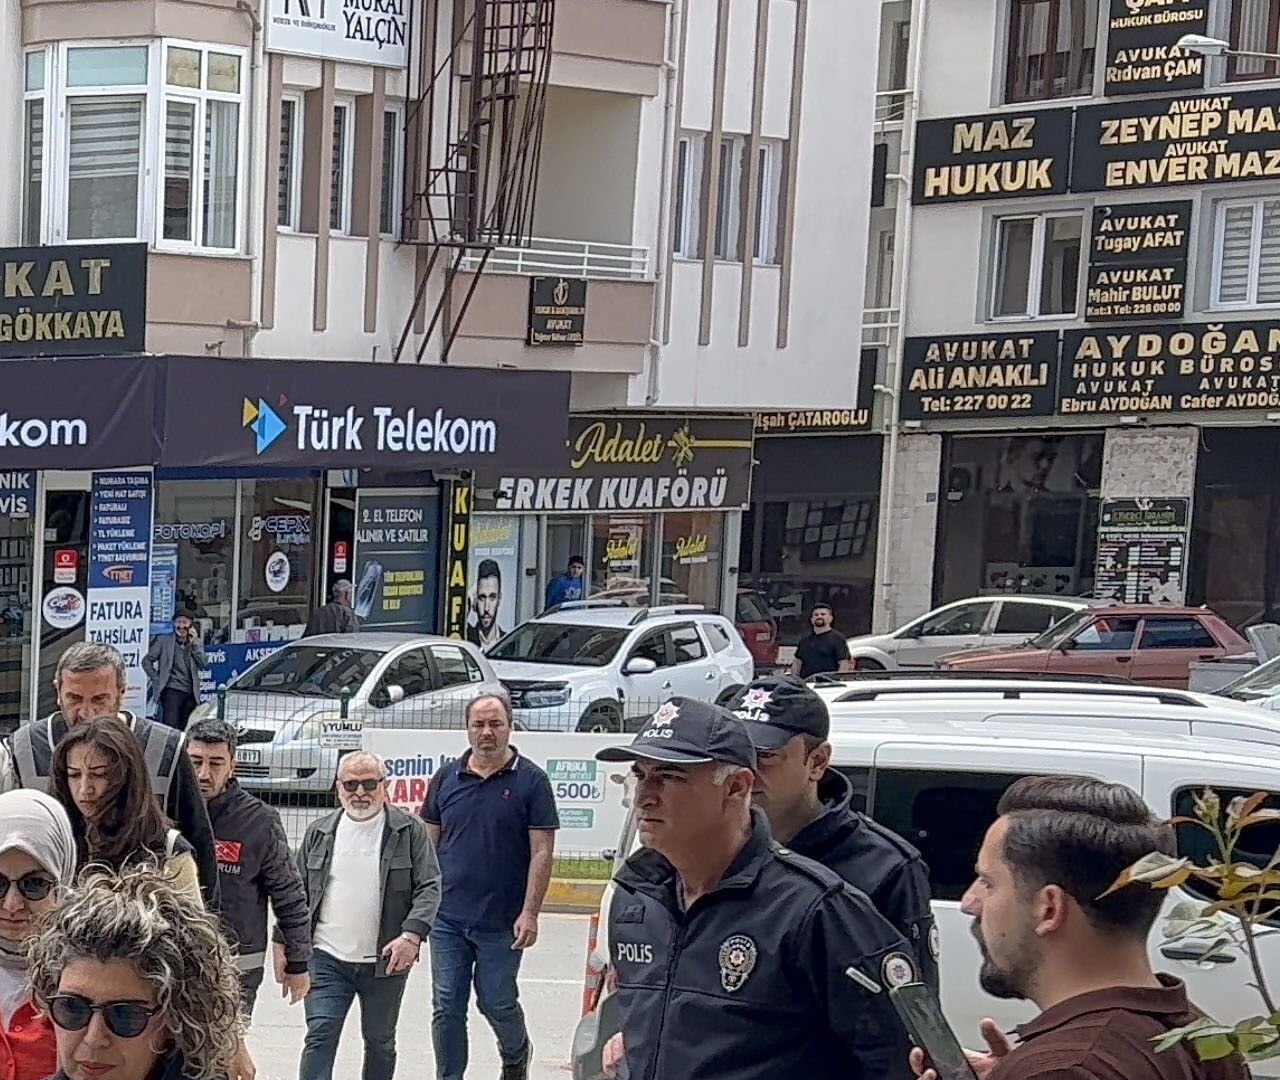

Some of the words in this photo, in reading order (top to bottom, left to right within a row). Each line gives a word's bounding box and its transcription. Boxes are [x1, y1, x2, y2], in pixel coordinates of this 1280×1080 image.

[1111, 14, 1153, 28] HUKUK
[1154, 9, 1203, 24] BÜROSU
[343, 10, 407, 49] YALÇIN
[1107, 65, 1160, 82] Rıdvan
[1164, 58, 1202, 81] ÇAM
[1169, 97, 1232, 114] AVUKAT
[953, 117, 1035, 153] MAZ
[1100, 112, 1222, 144] ZEYNEP
[1227, 106, 1280, 134] MA
[1165, 140, 1228, 157] AVUKAT
[924, 158, 1053, 197] HUKUK
[1106, 156, 1208, 186] ENVER
[1214, 150, 1280, 178] MAZ
[1100, 215, 1179, 231] AVUKAT
[1095, 236, 1141, 253] Tugay
[1142, 231, 1184, 248] AFAT
[1097, 268, 1175, 284] AVUKAT
[1089, 286, 1130, 303] Mahir
[1132, 284, 1183, 300] BULUT
[925, 338, 1034, 362] AVUKAT
[1073, 360, 1165, 378] HUKUK
[1180, 354, 1280, 374] BÜROS
[909, 367, 944, 391] Ali
[948, 363, 1048, 389] ANAKLI
[1076, 380, 1154, 394] AVUKAT
[1200, 376, 1280, 390] AVUKAT
[921, 397, 950, 412] Tel:
[953, 395, 983, 411] 227
[986, 395, 1008, 409] 00
[1010, 394, 1032, 409] 22
[1061, 398, 1097, 412] Ebru
[1099, 392, 1172, 411] AYDOĞAN
[1181, 394, 1224, 409] Cafer
[1226, 389, 1280, 408] AYDOĞ
[293, 405, 363, 451] Türk
[372, 406, 497, 453] Telekom
[756, 413, 785, 431] lşah
[570, 423, 665, 469] Adalet
[496, 477, 593, 510] ERKEK
[598, 468, 728, 508] KUAFÖRÜ
[373, 509, 383, 522] EL
[385, 509, 423, 522] TELEFON
[385, 529, 396, 542] VE
[90, 601, 143, 620] FATURA
[90, 625, 143, 644] TAHSİLAT
[385, 755, 433, 776] senin
[219, 864, 240, 874] RUM
